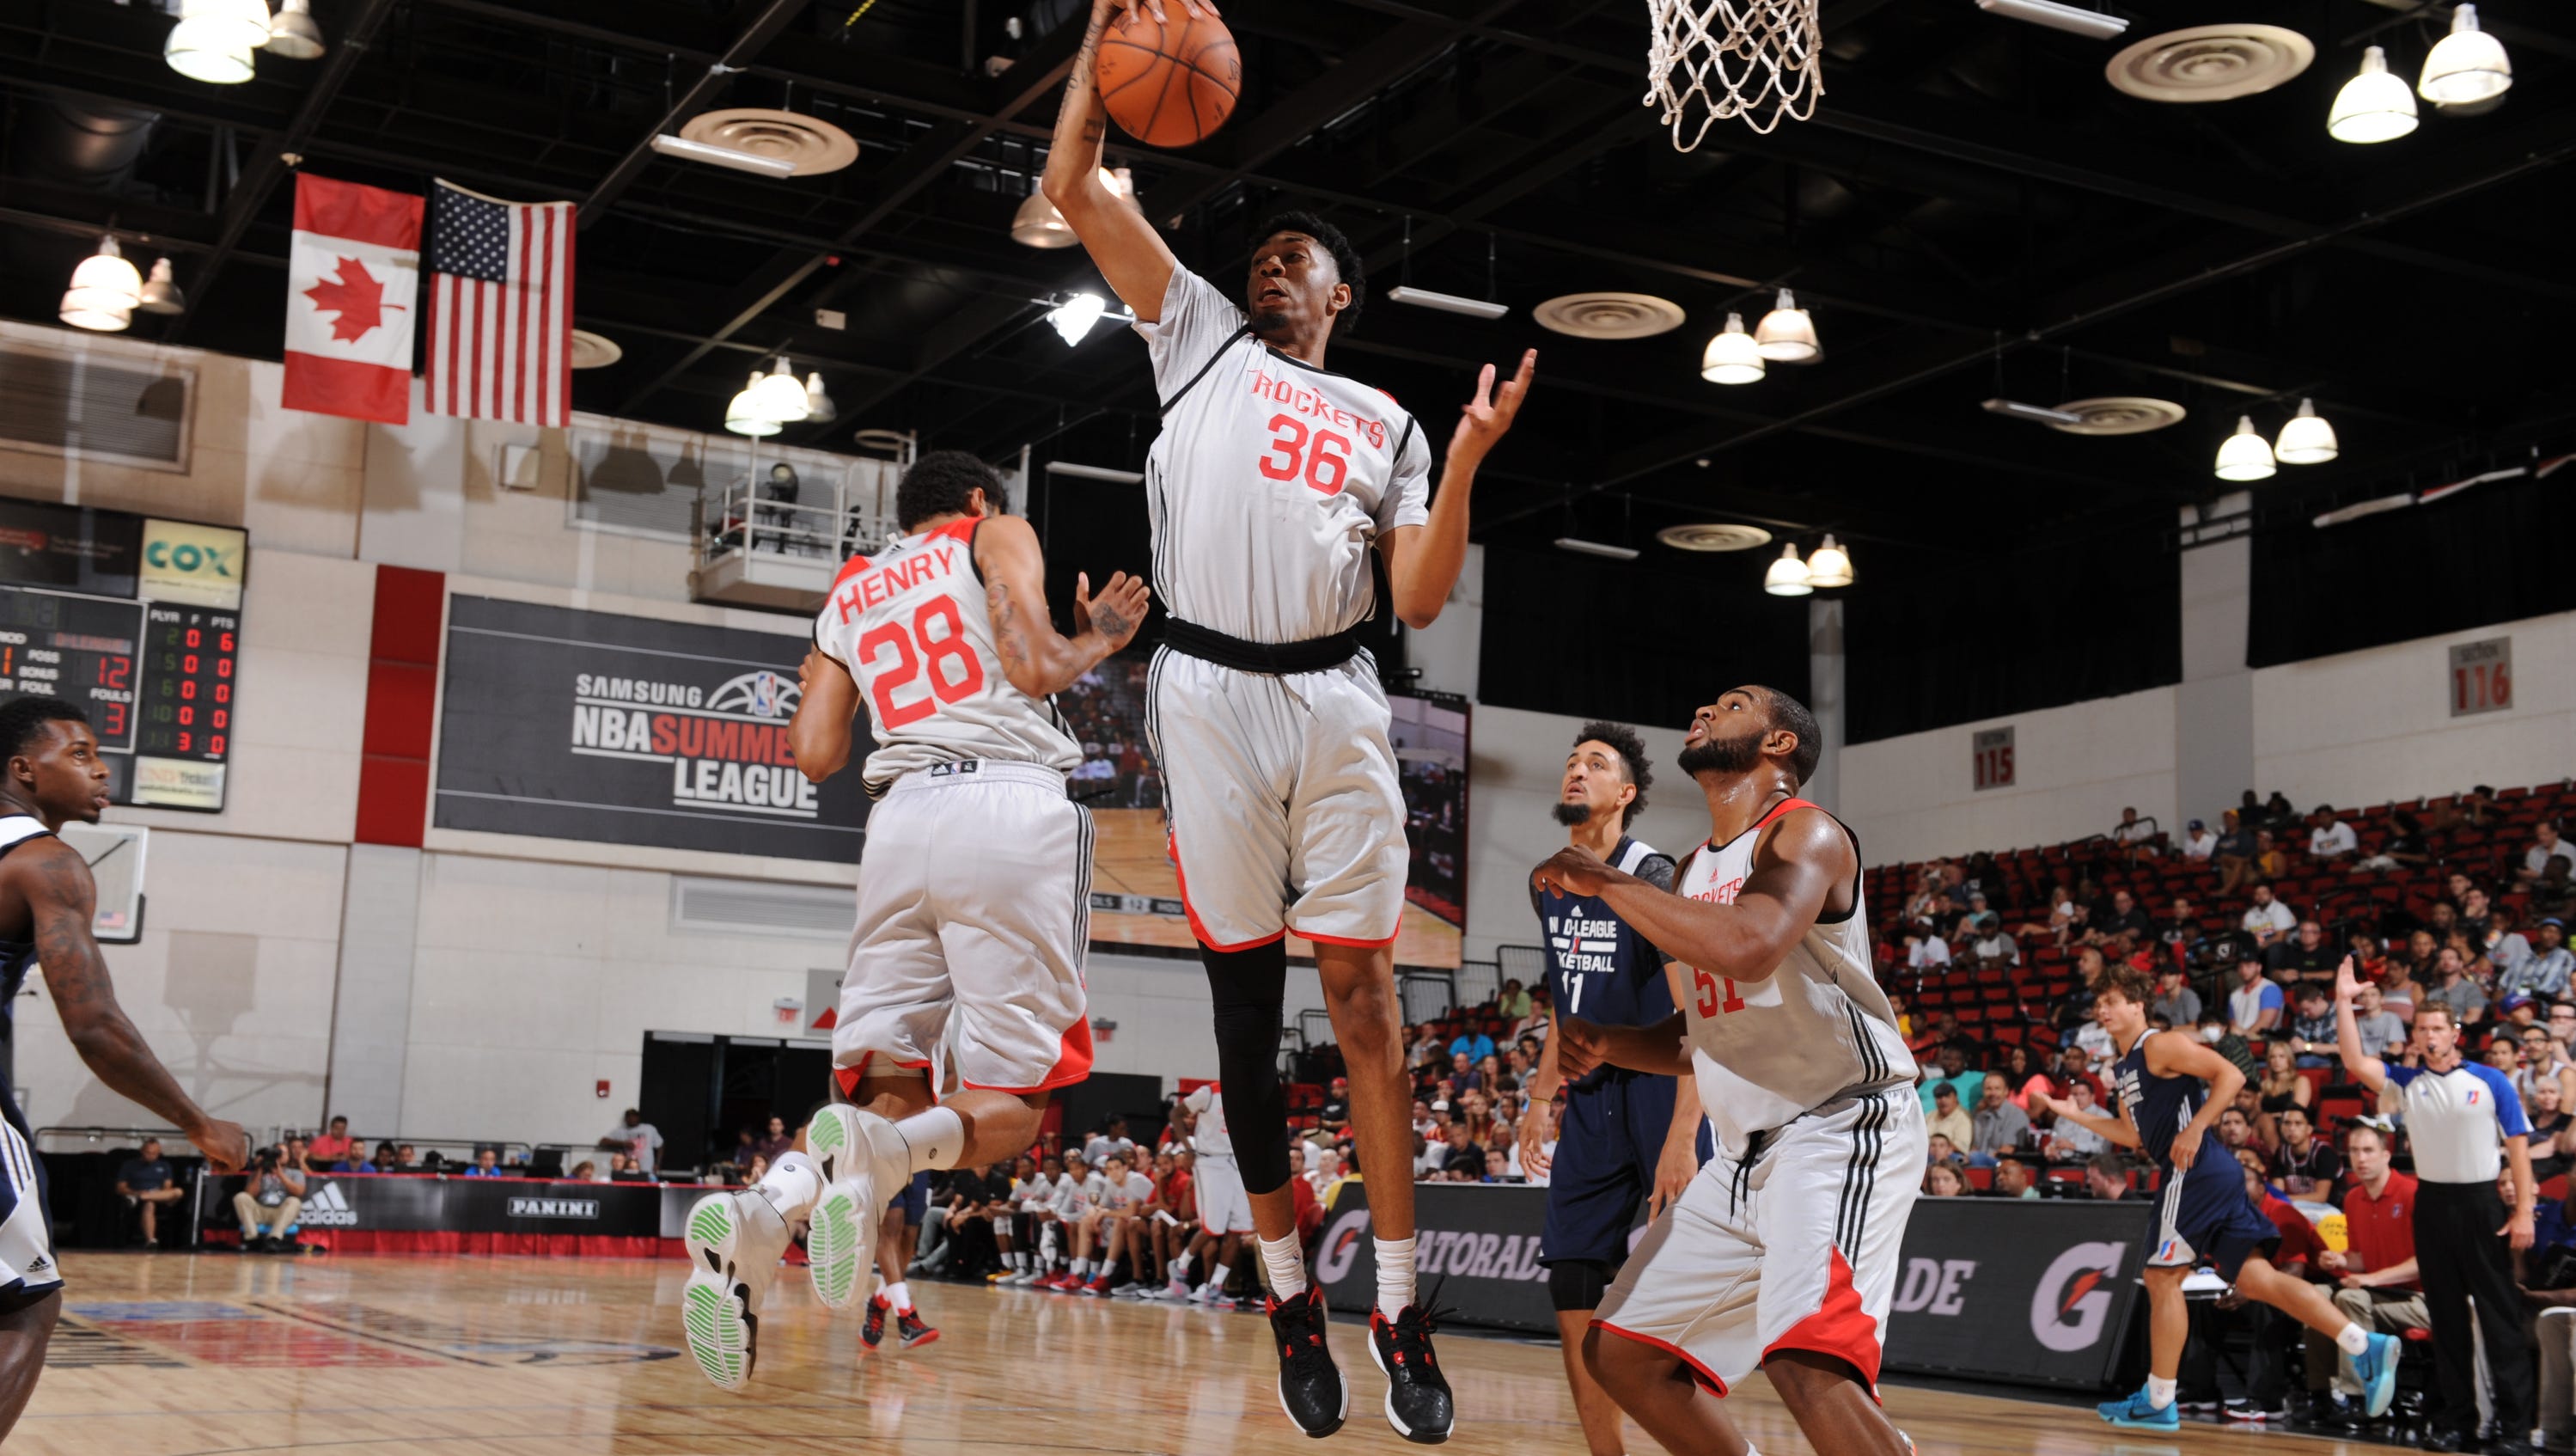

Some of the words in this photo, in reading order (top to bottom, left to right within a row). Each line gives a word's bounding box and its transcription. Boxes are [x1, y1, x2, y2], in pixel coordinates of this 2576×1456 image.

[1248, 369, 1385, 450] ROCKETS
[1259, 413, 1352, 497] 36
[146, 541, 236, 577] COX
[836, 546, 955, 626] HENRY
[186, 628, 201, 649] 0
[220, 632, 235, 652] 6
[191, 614, 200, 625] F
[211, 616, 235, 630] PTS
[19, 665, 59, 681] BONUS
[27, 649, 60, 664] POSS
[98, 656, 131, 688] 12
[184, 654, 199, 675] 0
[217, 658, 232, 678] 0
[857, 593, 984, 731] 28
[19, 680, 56, 695] FOUL
[89, 688, 133, 703] FOULS
[181, 680, 197, 700] 0
[215, 683, 230, 704] 0
[575, 673, 703, 709] SAMSUNG
[2455, 662, 2511, 712] 116
[105, 702, 126, 736] 3
[179, 705, 194, 726] 0
[213, 709, 228, 730] 0
[177, 731, 192, 752] 3
[211, 735, 225, 755] 0
[651, 713, 796, 768] SUMME
[1976, 745, 2014, 786] 115
[674, 759, 819, 810] LEAGUE
[1562, 918, 1617, 939] D-LEAGUE
[1556, 951, 1615, 973] KETBALL
[1561, 970, 1584, 1014] 11
[1693, 968, 1745, 1019] 51
[512, 1199, 595, 1216] PANINI
[1315, 1208, 1370, 1284] G
[1414, 1229, 1552, 1283] ATORAD
[1890, 1257, 1977, 1316] DE
[2030, 1240, 2128, 1353] G
